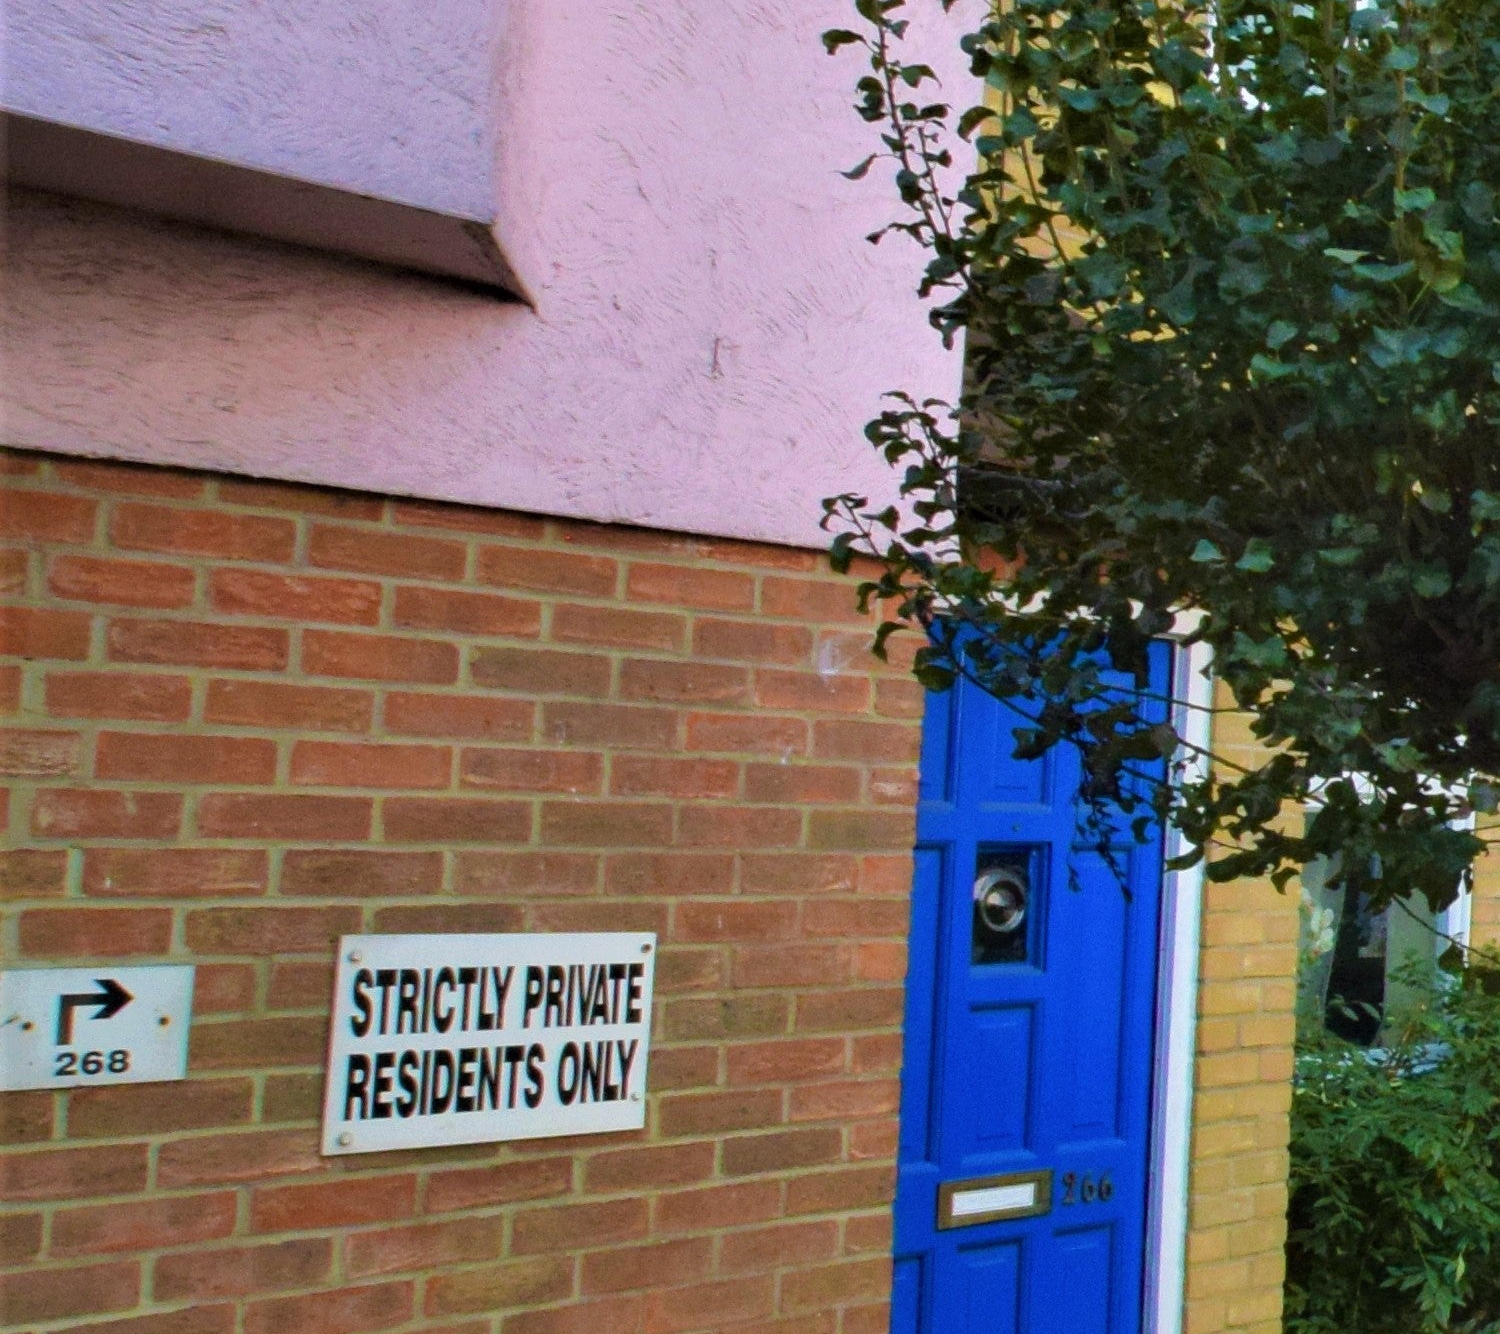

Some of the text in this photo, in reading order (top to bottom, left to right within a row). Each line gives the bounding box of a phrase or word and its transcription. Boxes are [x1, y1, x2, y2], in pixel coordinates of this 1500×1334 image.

[350, 963, 645, 1037] STRICTLY PRIVATE
[55, 1049, 132, 1076] 268
[343, 1039, 639, 1121] RESIDENTS ONLY
[1062, 1169, 1114, 1206] 266
